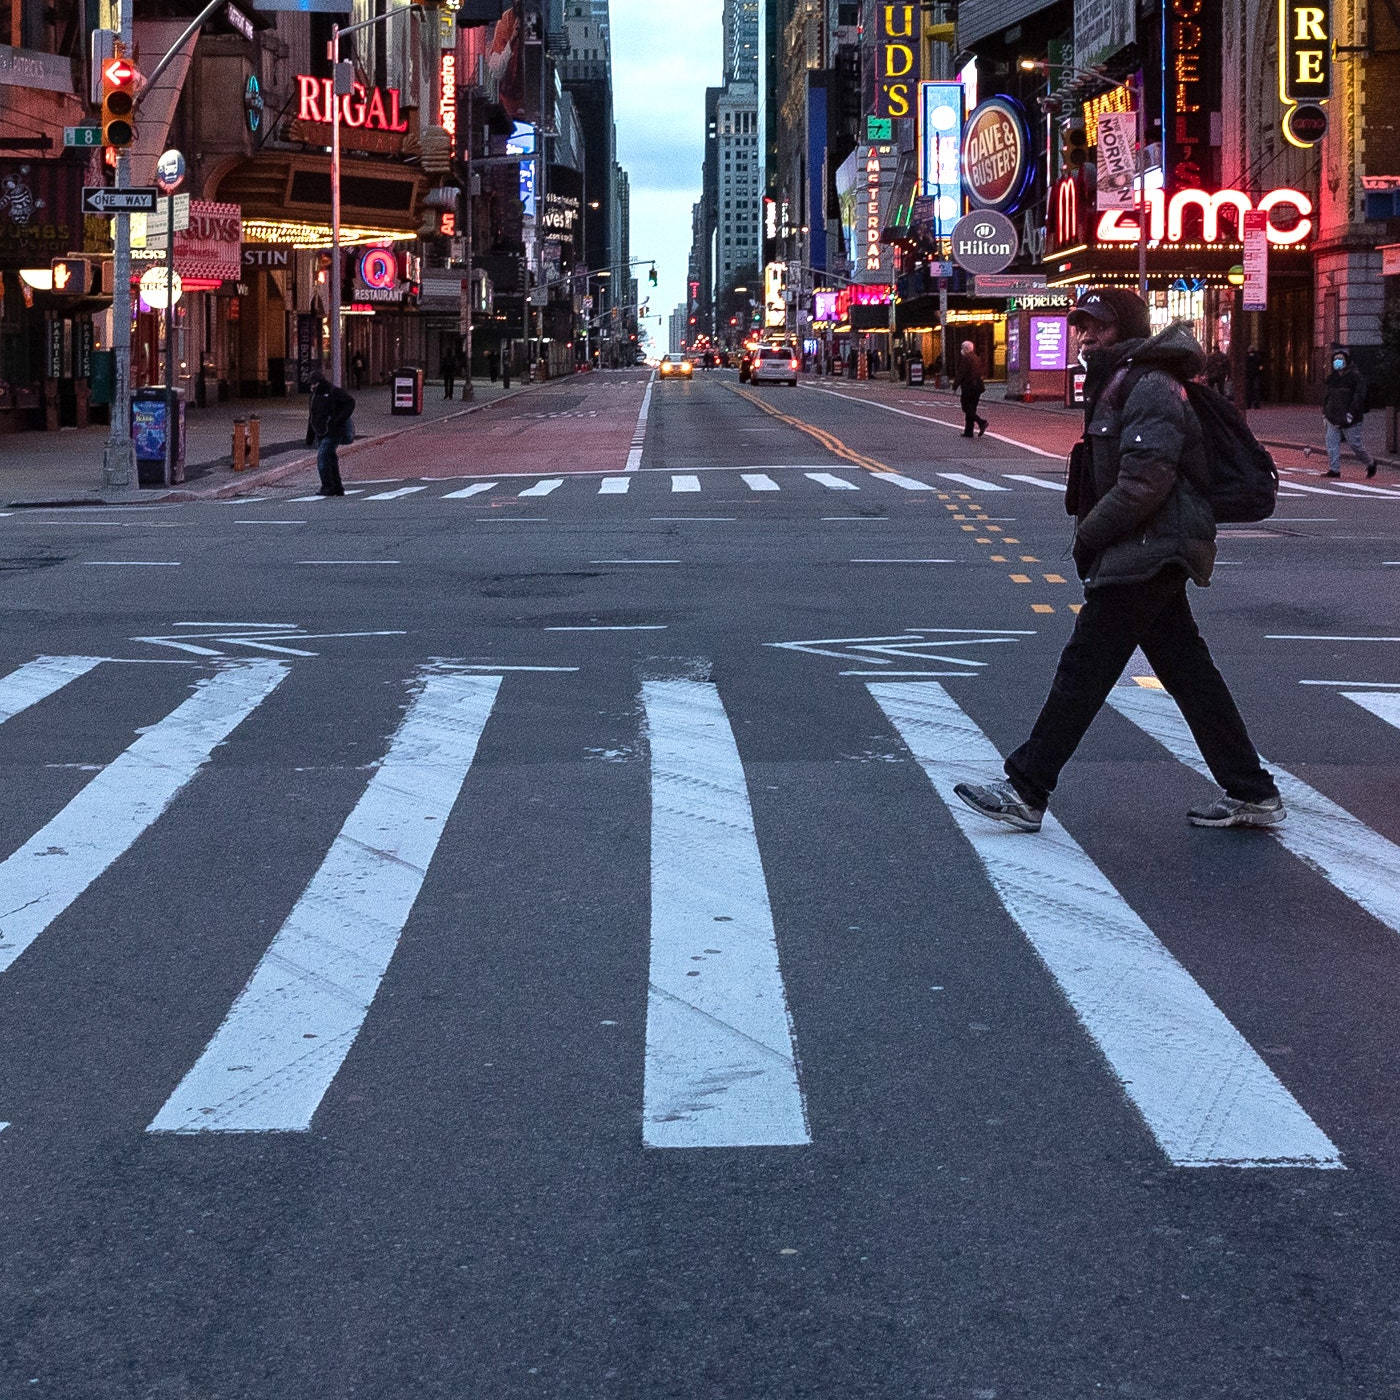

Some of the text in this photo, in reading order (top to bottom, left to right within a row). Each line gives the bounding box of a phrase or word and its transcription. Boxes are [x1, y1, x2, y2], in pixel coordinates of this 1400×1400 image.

[84, 129, 93, 145] 8
[970, 124, 1002, 163] DAVE
[1002, 121, 1015, 143] &
[973, 147, 1016, 187] BUSTER'S
[1100, 118, 1132, 203] MORMON
[94, 195, 149, 206] ONE WAY
[1096, 187, 1313, 245] amc
[244, 250, 288, 265] STIN
[958, 240, 1010, 256] Hilton
[360, 248, 398, 290] Q
[354, 288, 404, 301] RESTAURANT
